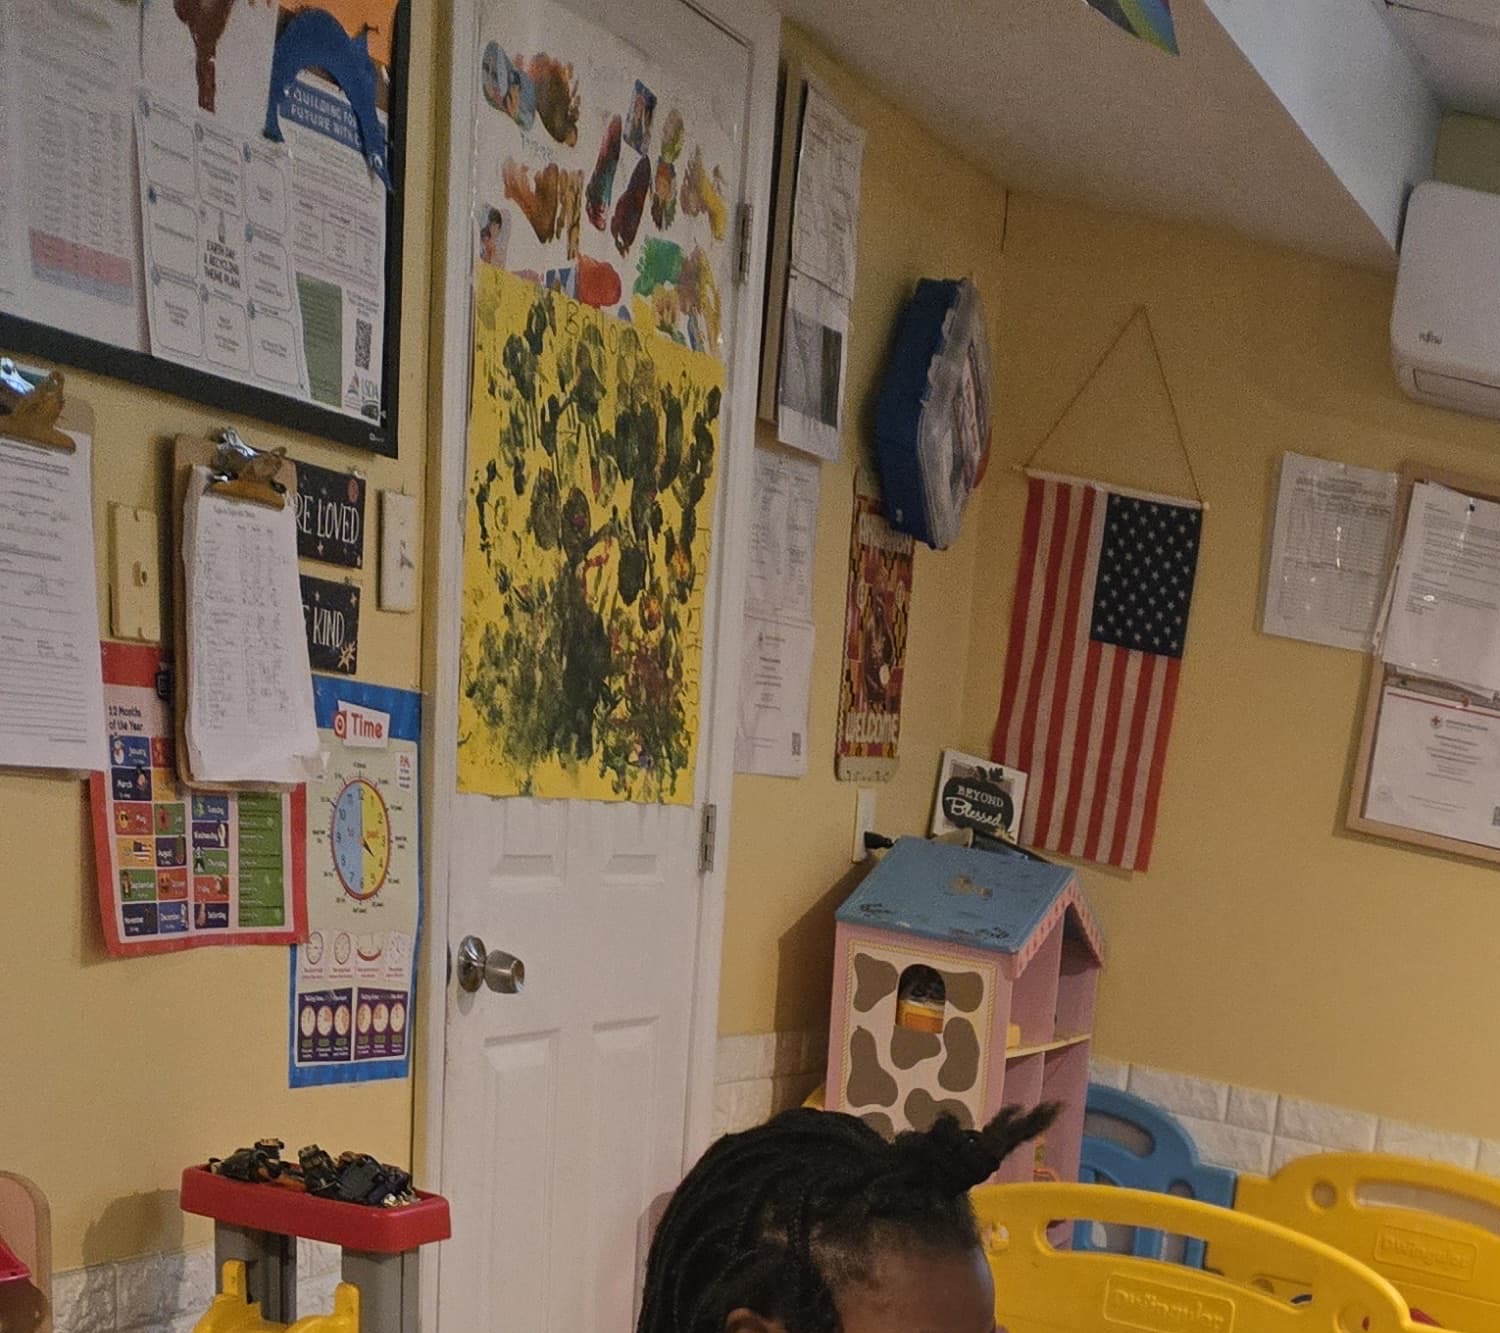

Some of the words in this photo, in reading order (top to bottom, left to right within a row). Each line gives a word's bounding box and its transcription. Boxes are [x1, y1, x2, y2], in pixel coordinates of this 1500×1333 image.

[296, 493, 313, 534] RE
[317, 499, 360, 544] LOVED
[313, 607, 345, 650] KIND
[351, 712, 382, 739] Time
[945, 796, 1004, 826] Blessed
[957, 785, 1004, 808] BEYOND
